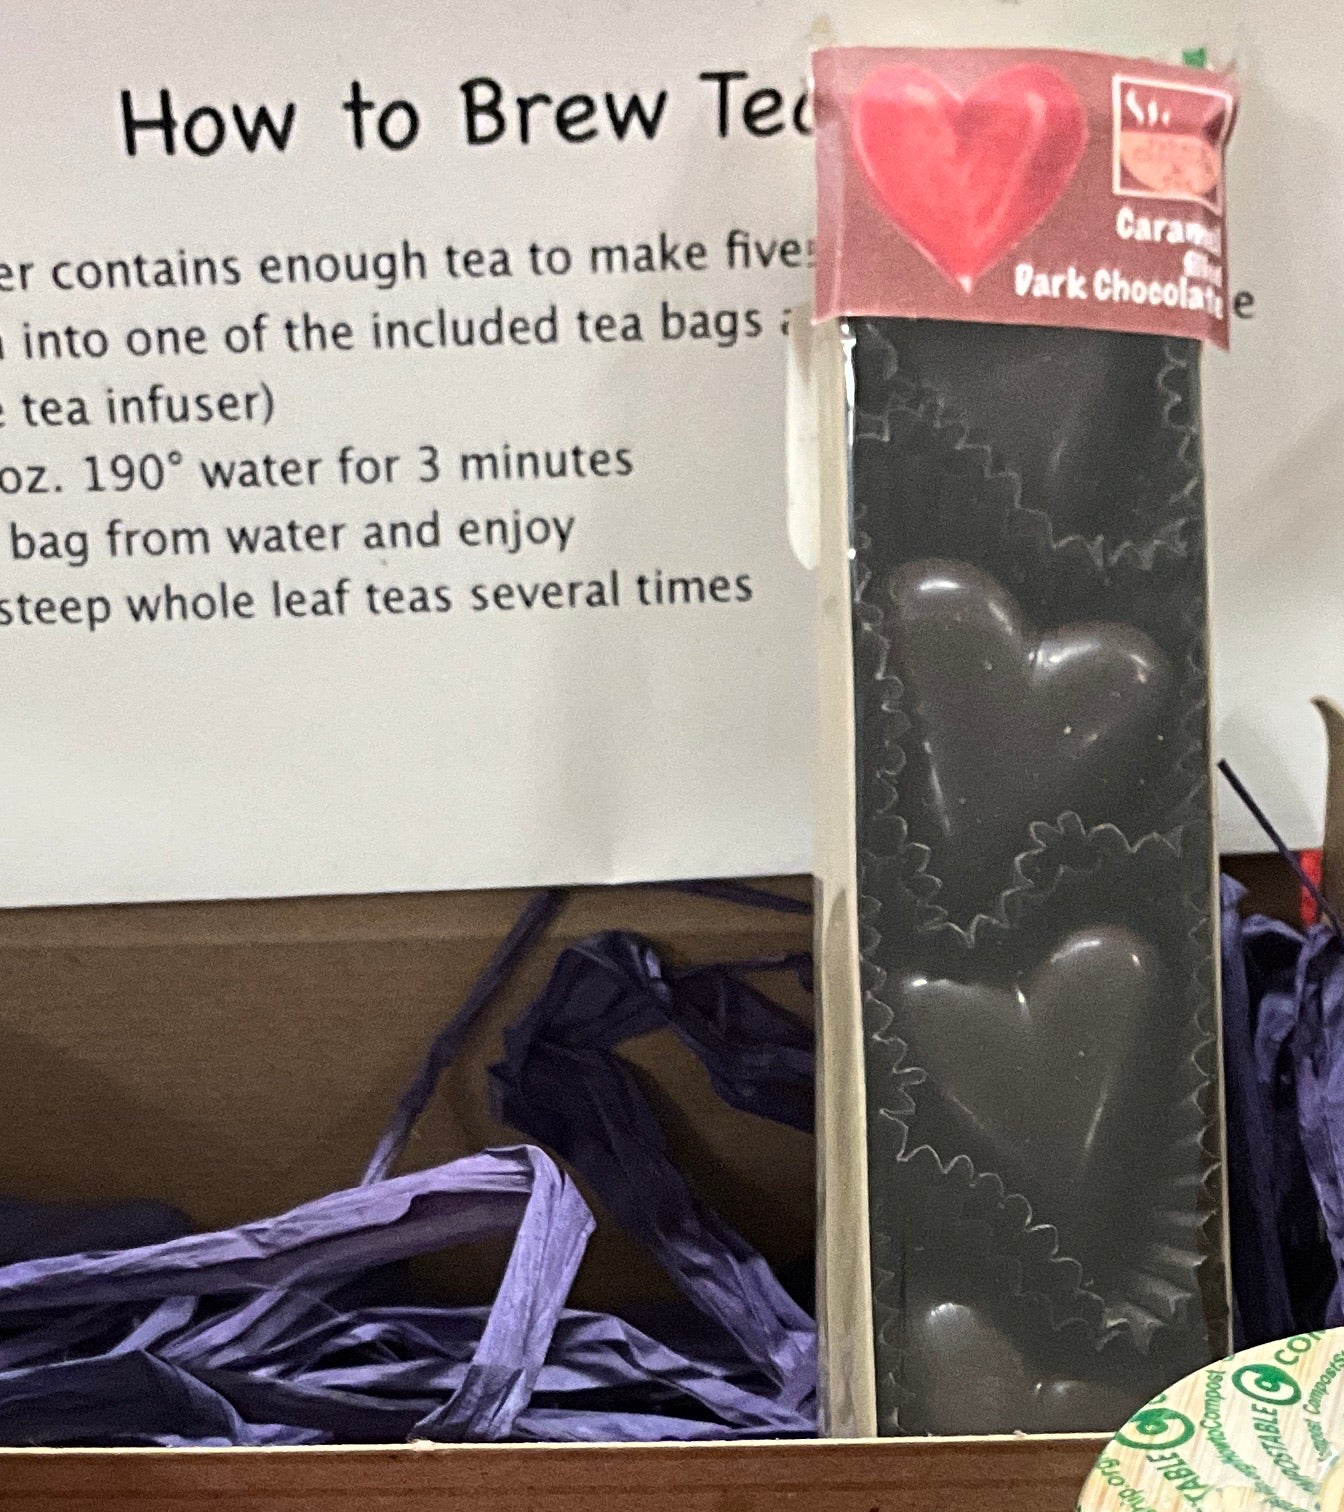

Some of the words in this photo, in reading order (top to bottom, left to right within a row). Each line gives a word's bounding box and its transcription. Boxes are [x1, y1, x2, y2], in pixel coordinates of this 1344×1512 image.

[121, 86, 296, 157] How
[345, 80, 420, 151] to
[460, 76, 667, 145] Brew
[52, 250, 240, 290] contains
[260, 241, 427, 290] enough
[447, 241, 512, 279] tea
[529, 241, 572, 276] to
[590, 233, 707, 274] make
[1015, 263, 1087, 300] Dark
[24, 322, 108, 359] into
[127, 322, 206, 354] one
[226, 312, 268, 354] of
[286, 312, 354, 352] the
[372, 305, 557, 351] included
[577, 307, 642, 342] tea
[661, 302, 762, 348] bags
[22, 392, 89, 428] tea
[107, 382, 274, 426] infuser)
[201, 451, 318, 489] water
[338, 445, 400, 484] for
[417, 446, 441, 482] 3
[460, 442, 633, 481] minutes
[12, 523, 88, 568] bag
[107, 520, 210, 556] from
[226, 518, 345, 554] water
[364, 511, 440, 551] and
[459, 512, 574, 554] enjoy
[128, 583, 254, 622] whole
[273, 578, 350, 618] leaf
[367, 579, 452, 614] teas
[470, 569, 620, 613] several
[637, 569, 754, 607] times
